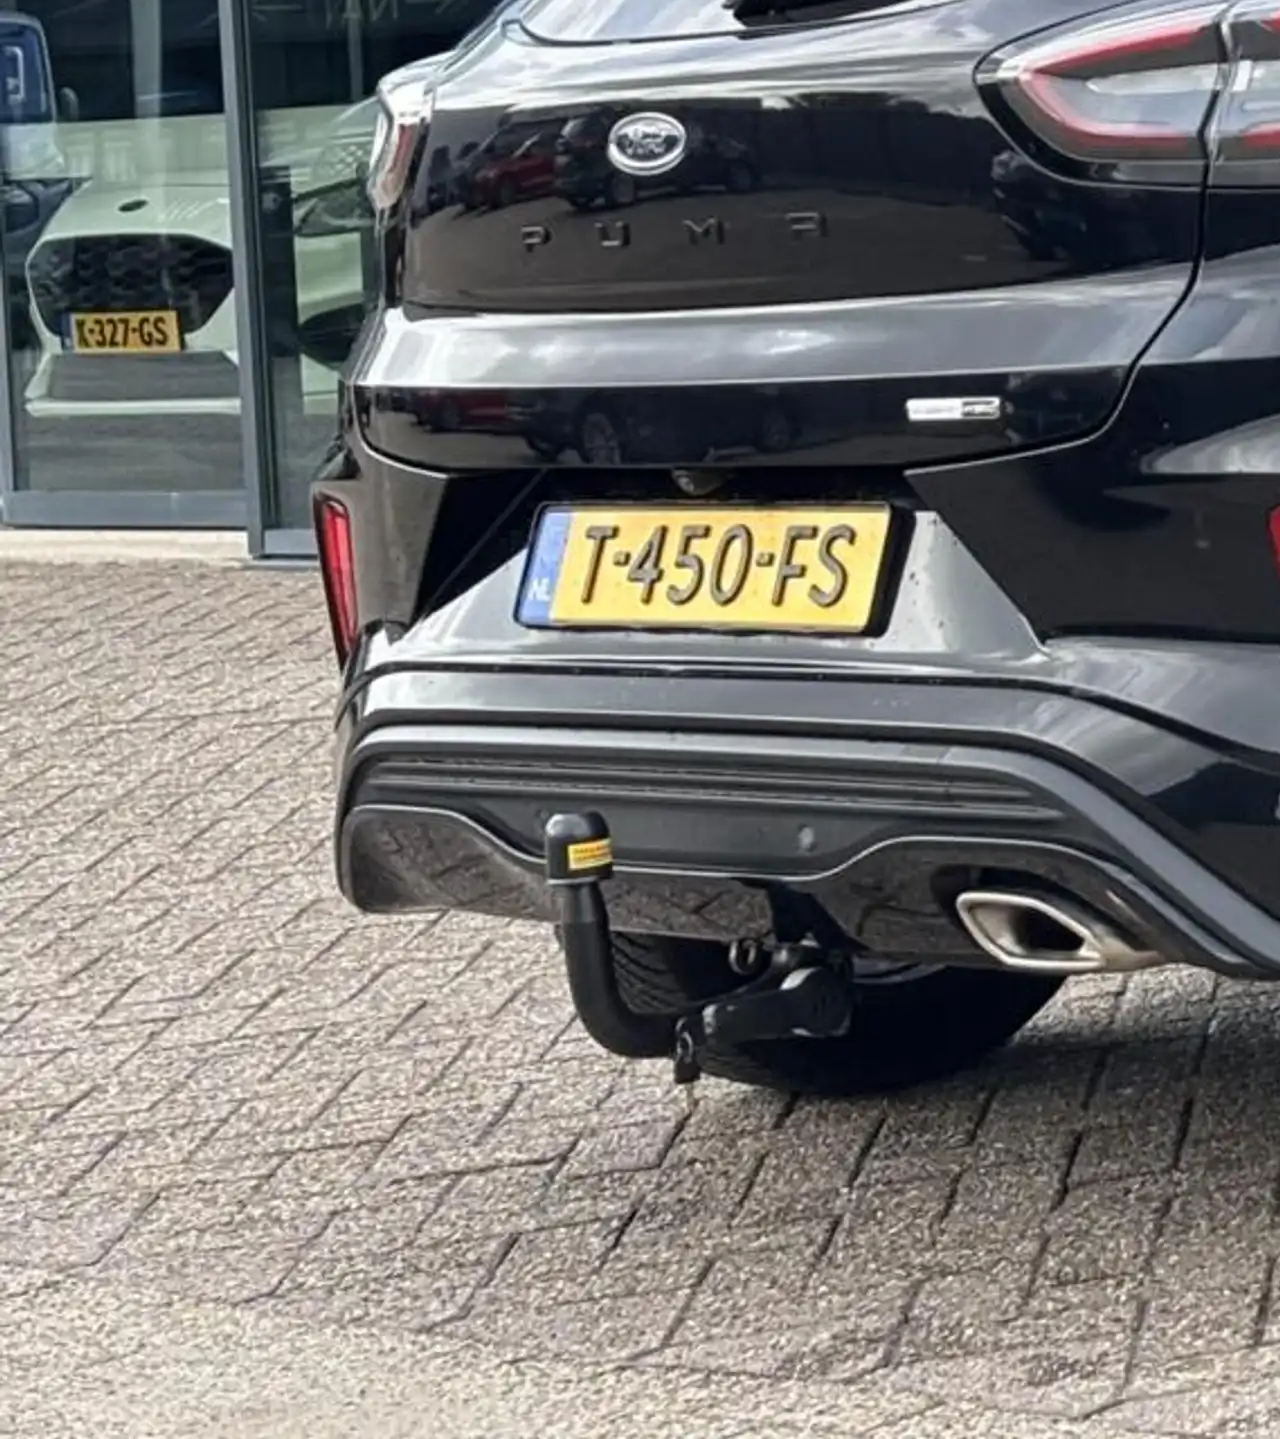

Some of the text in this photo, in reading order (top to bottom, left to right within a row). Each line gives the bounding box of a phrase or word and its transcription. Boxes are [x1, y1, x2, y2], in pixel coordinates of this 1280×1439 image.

[519, 211, 829, 253] PUMA
[76, 316, 168, 348] K-327-GS
[580, 523, 857, 608] T-450-FS
